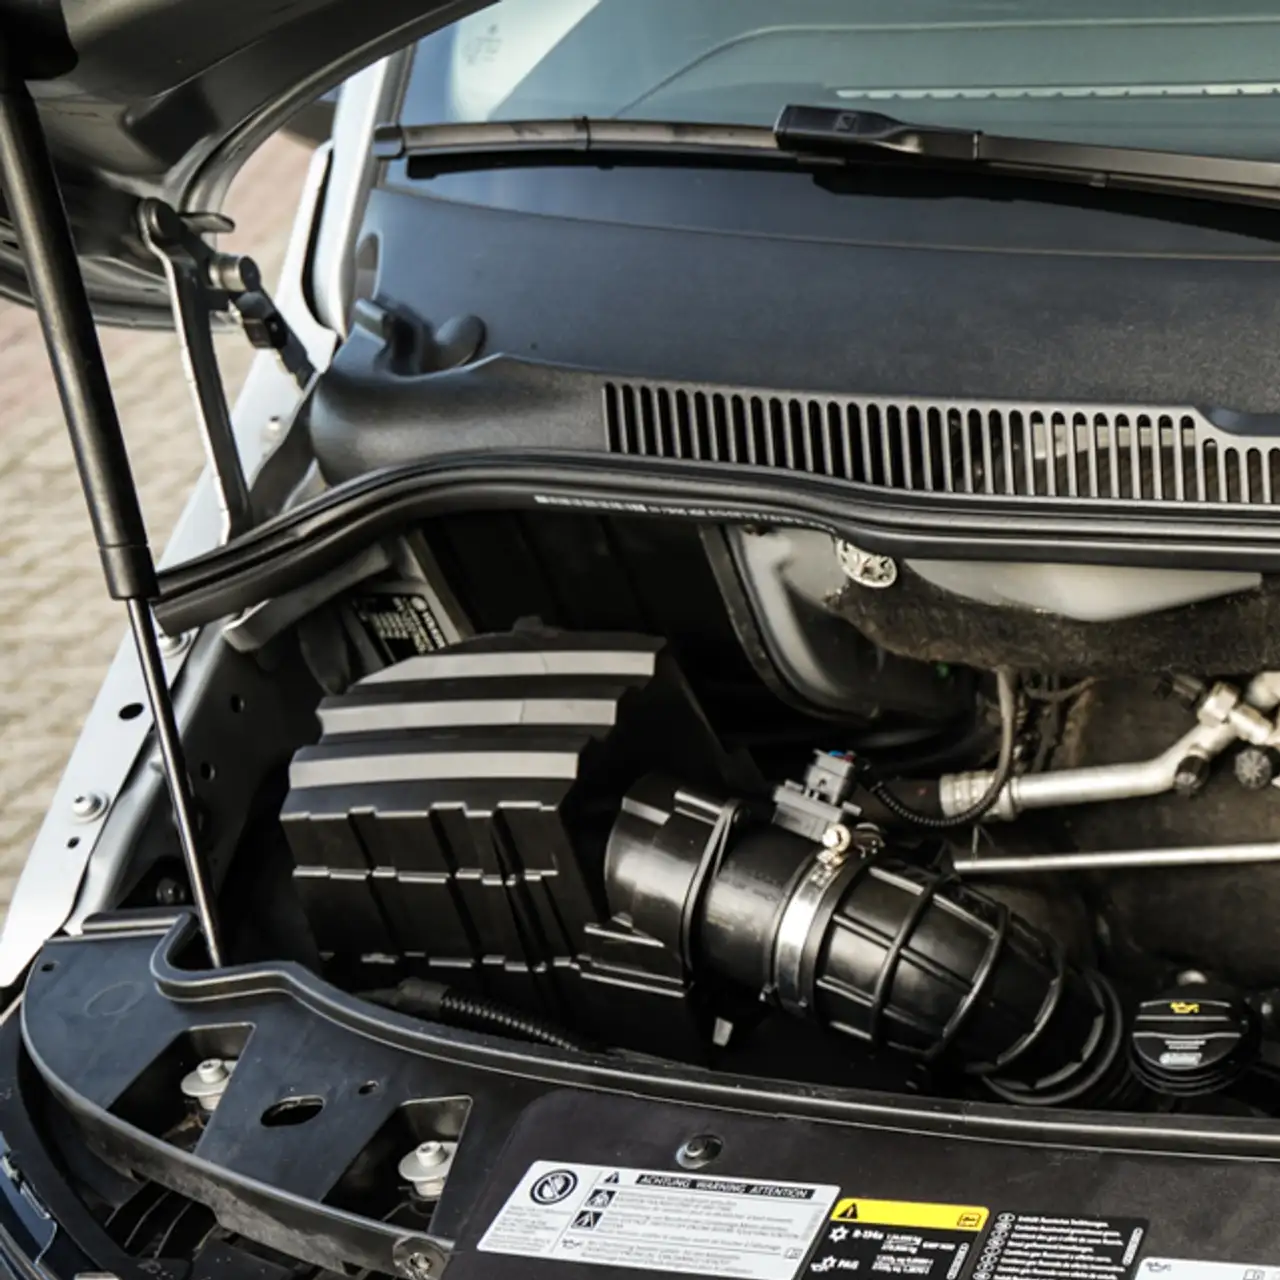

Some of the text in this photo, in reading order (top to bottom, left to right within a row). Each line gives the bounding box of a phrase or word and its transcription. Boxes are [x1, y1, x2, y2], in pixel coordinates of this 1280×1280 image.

[640, 1176, 808, 1198] ACHTUNG WARNING ATTENTION
